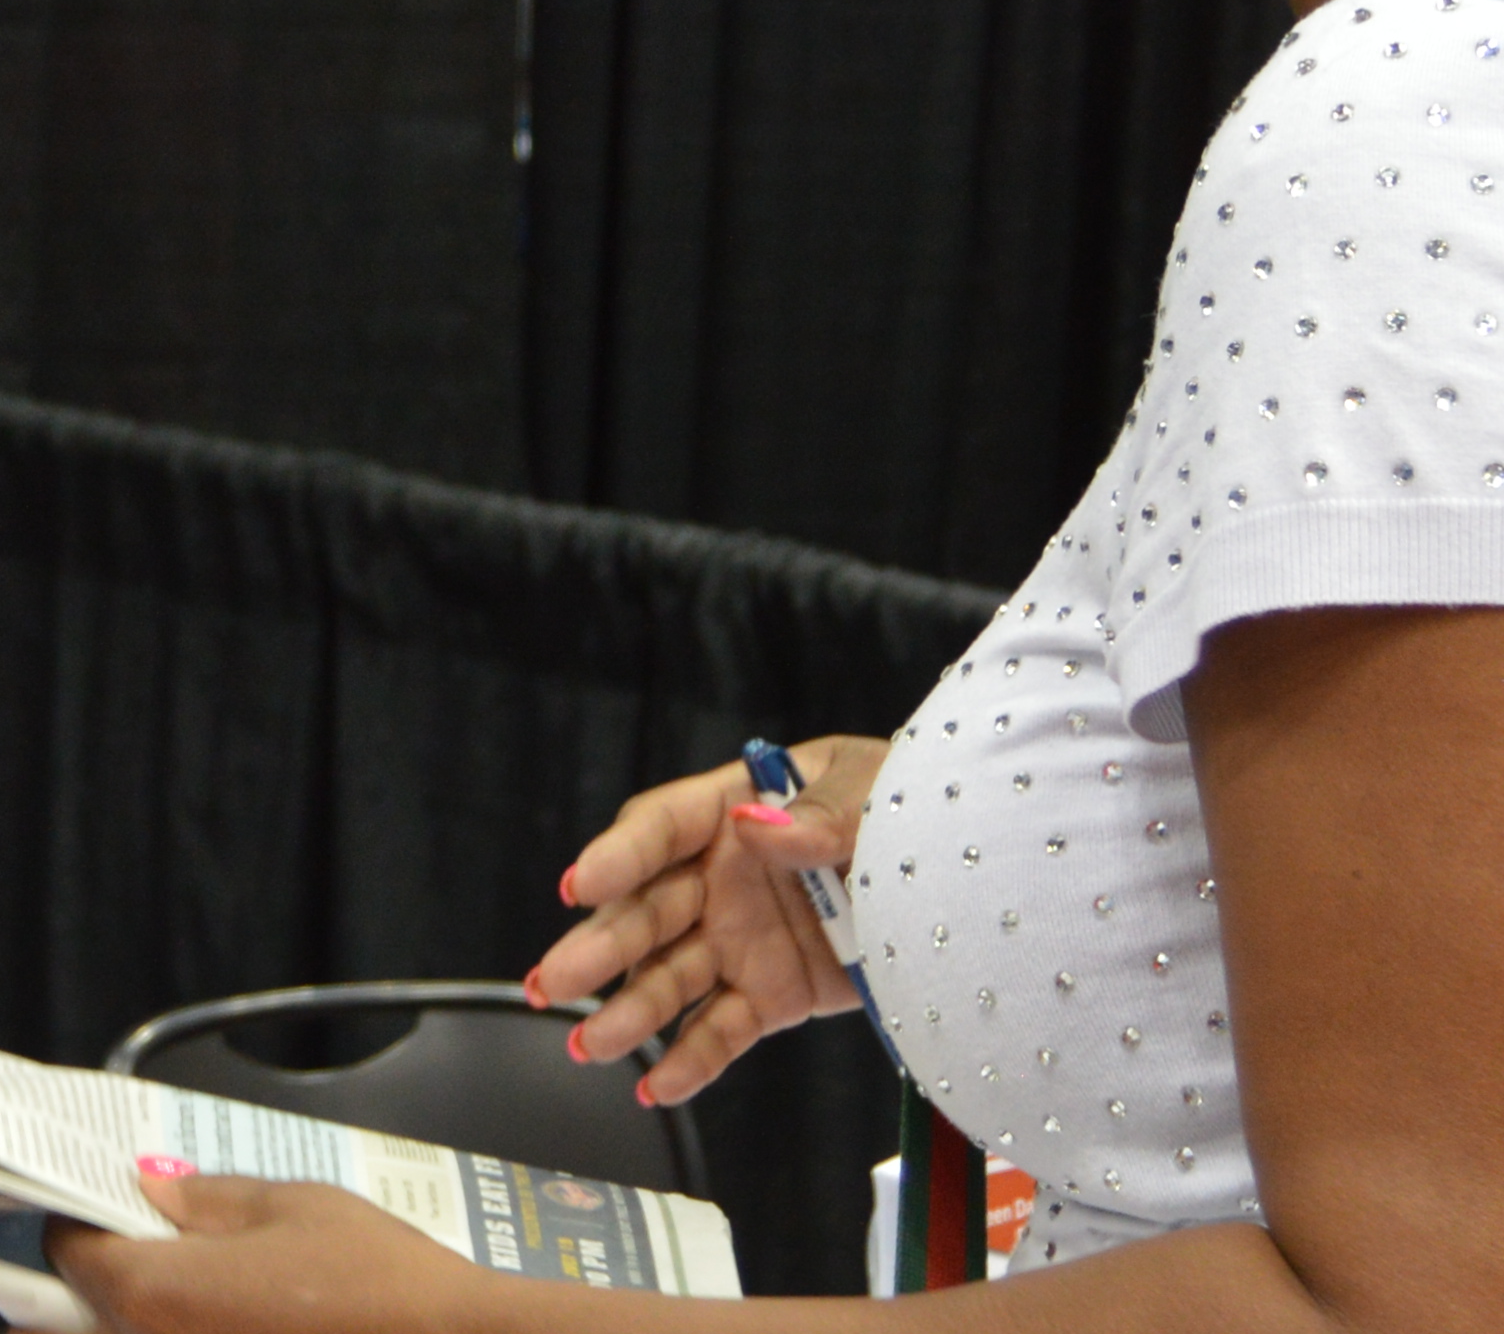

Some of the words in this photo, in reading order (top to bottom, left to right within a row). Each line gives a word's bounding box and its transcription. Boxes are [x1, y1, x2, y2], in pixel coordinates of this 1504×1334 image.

[477, 1176, 513, 1216] EAT
[484, 1219, 522, 1272] KIDS
[578, 1238, 607, 1270] PM
